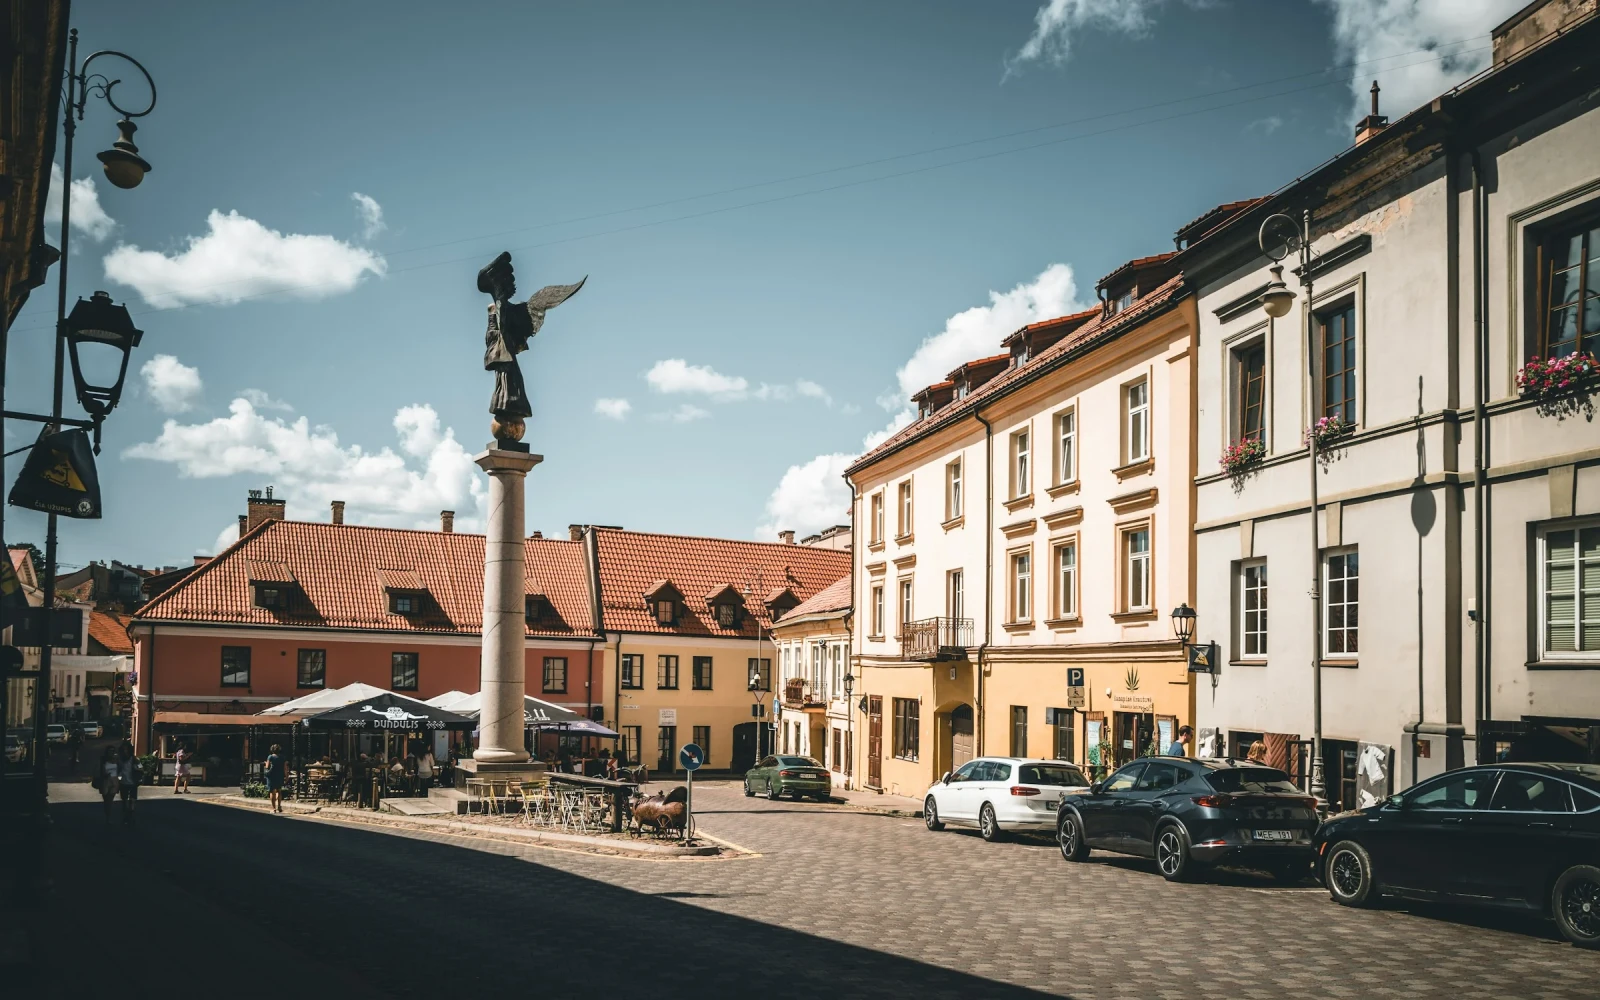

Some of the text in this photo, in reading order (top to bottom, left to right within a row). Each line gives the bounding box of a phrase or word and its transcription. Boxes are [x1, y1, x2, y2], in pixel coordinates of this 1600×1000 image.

[34, 500, 46, 508] ČIA
[47, 503, 72, 513] UŽUPIS
[1072, 670, 1081, 685] P
[374, 720, 419, 729] DUNDULIS
[1256, 830, 1291, 839] MEE 191
